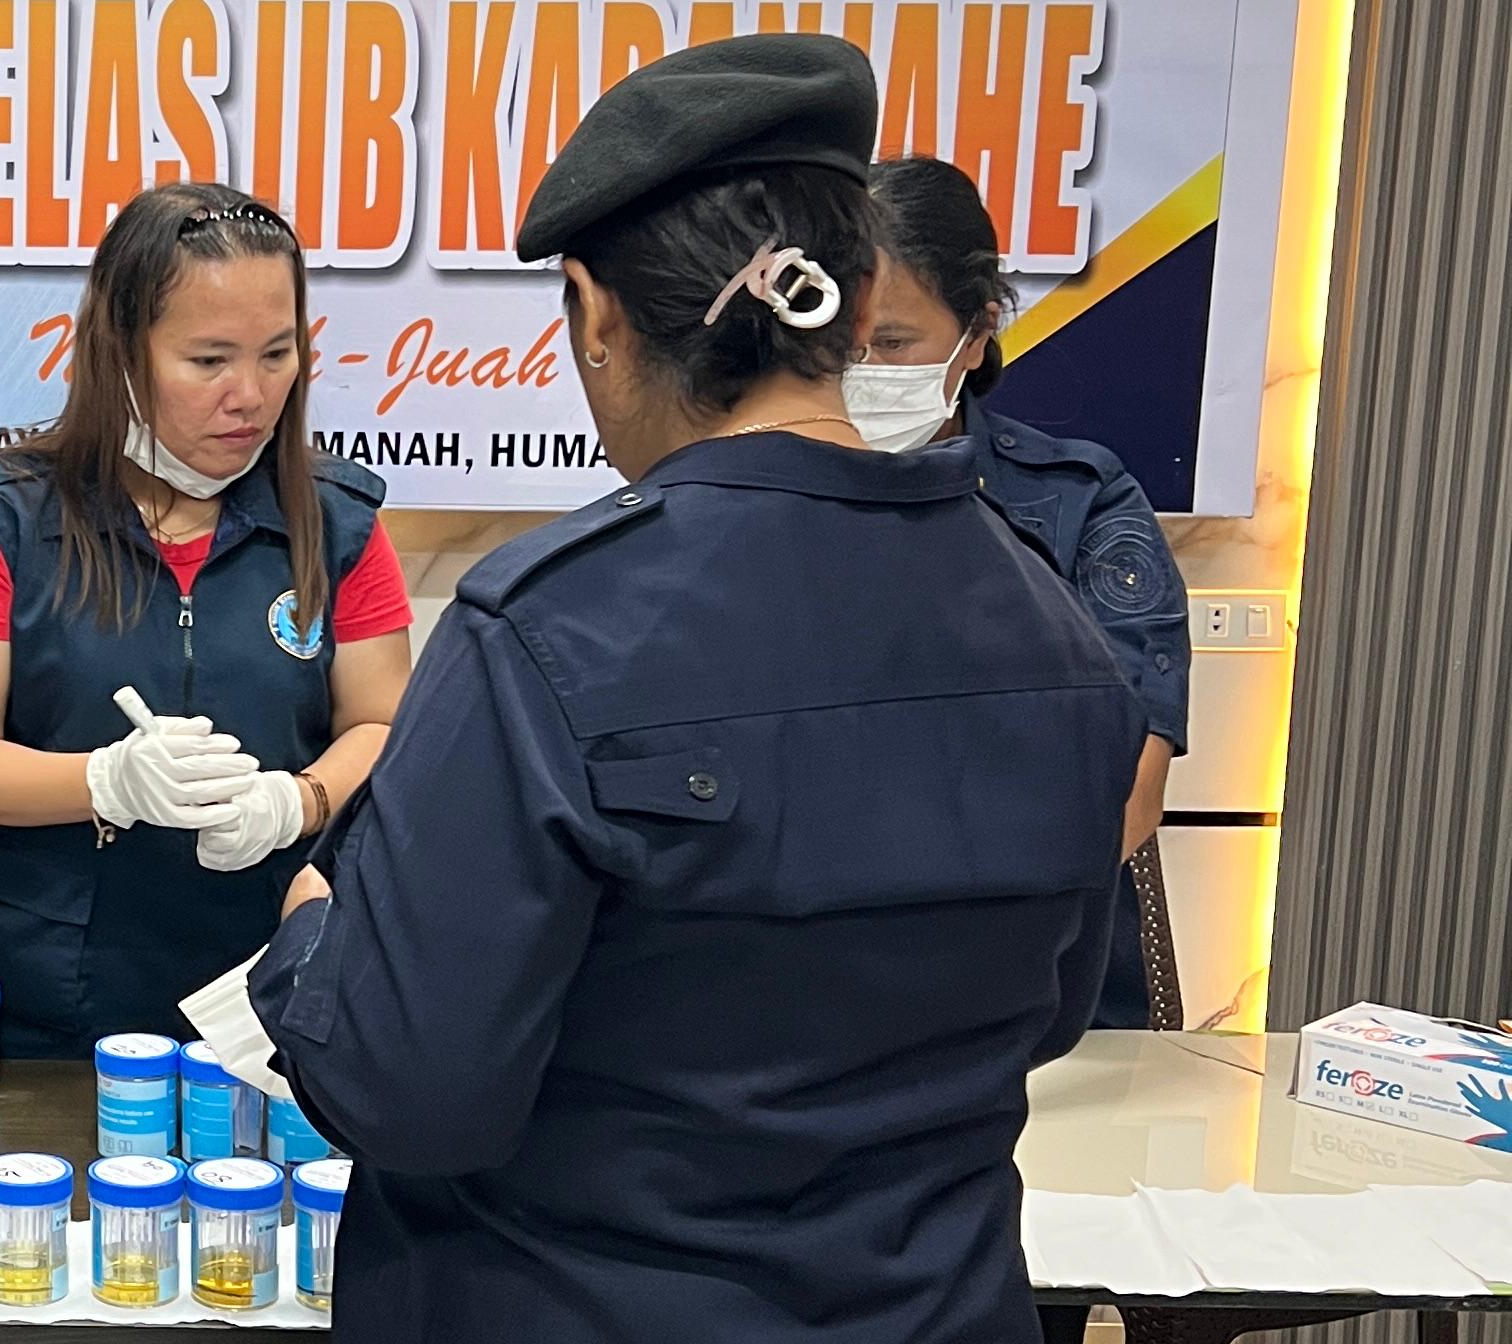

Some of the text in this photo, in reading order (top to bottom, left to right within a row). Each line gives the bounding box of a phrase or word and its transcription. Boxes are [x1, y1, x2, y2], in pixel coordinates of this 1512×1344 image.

[250, 0, 406, 251] IIB
[376, 317, 565, 416] Juah
[1316, 1059, 1404, 1100] feroze
